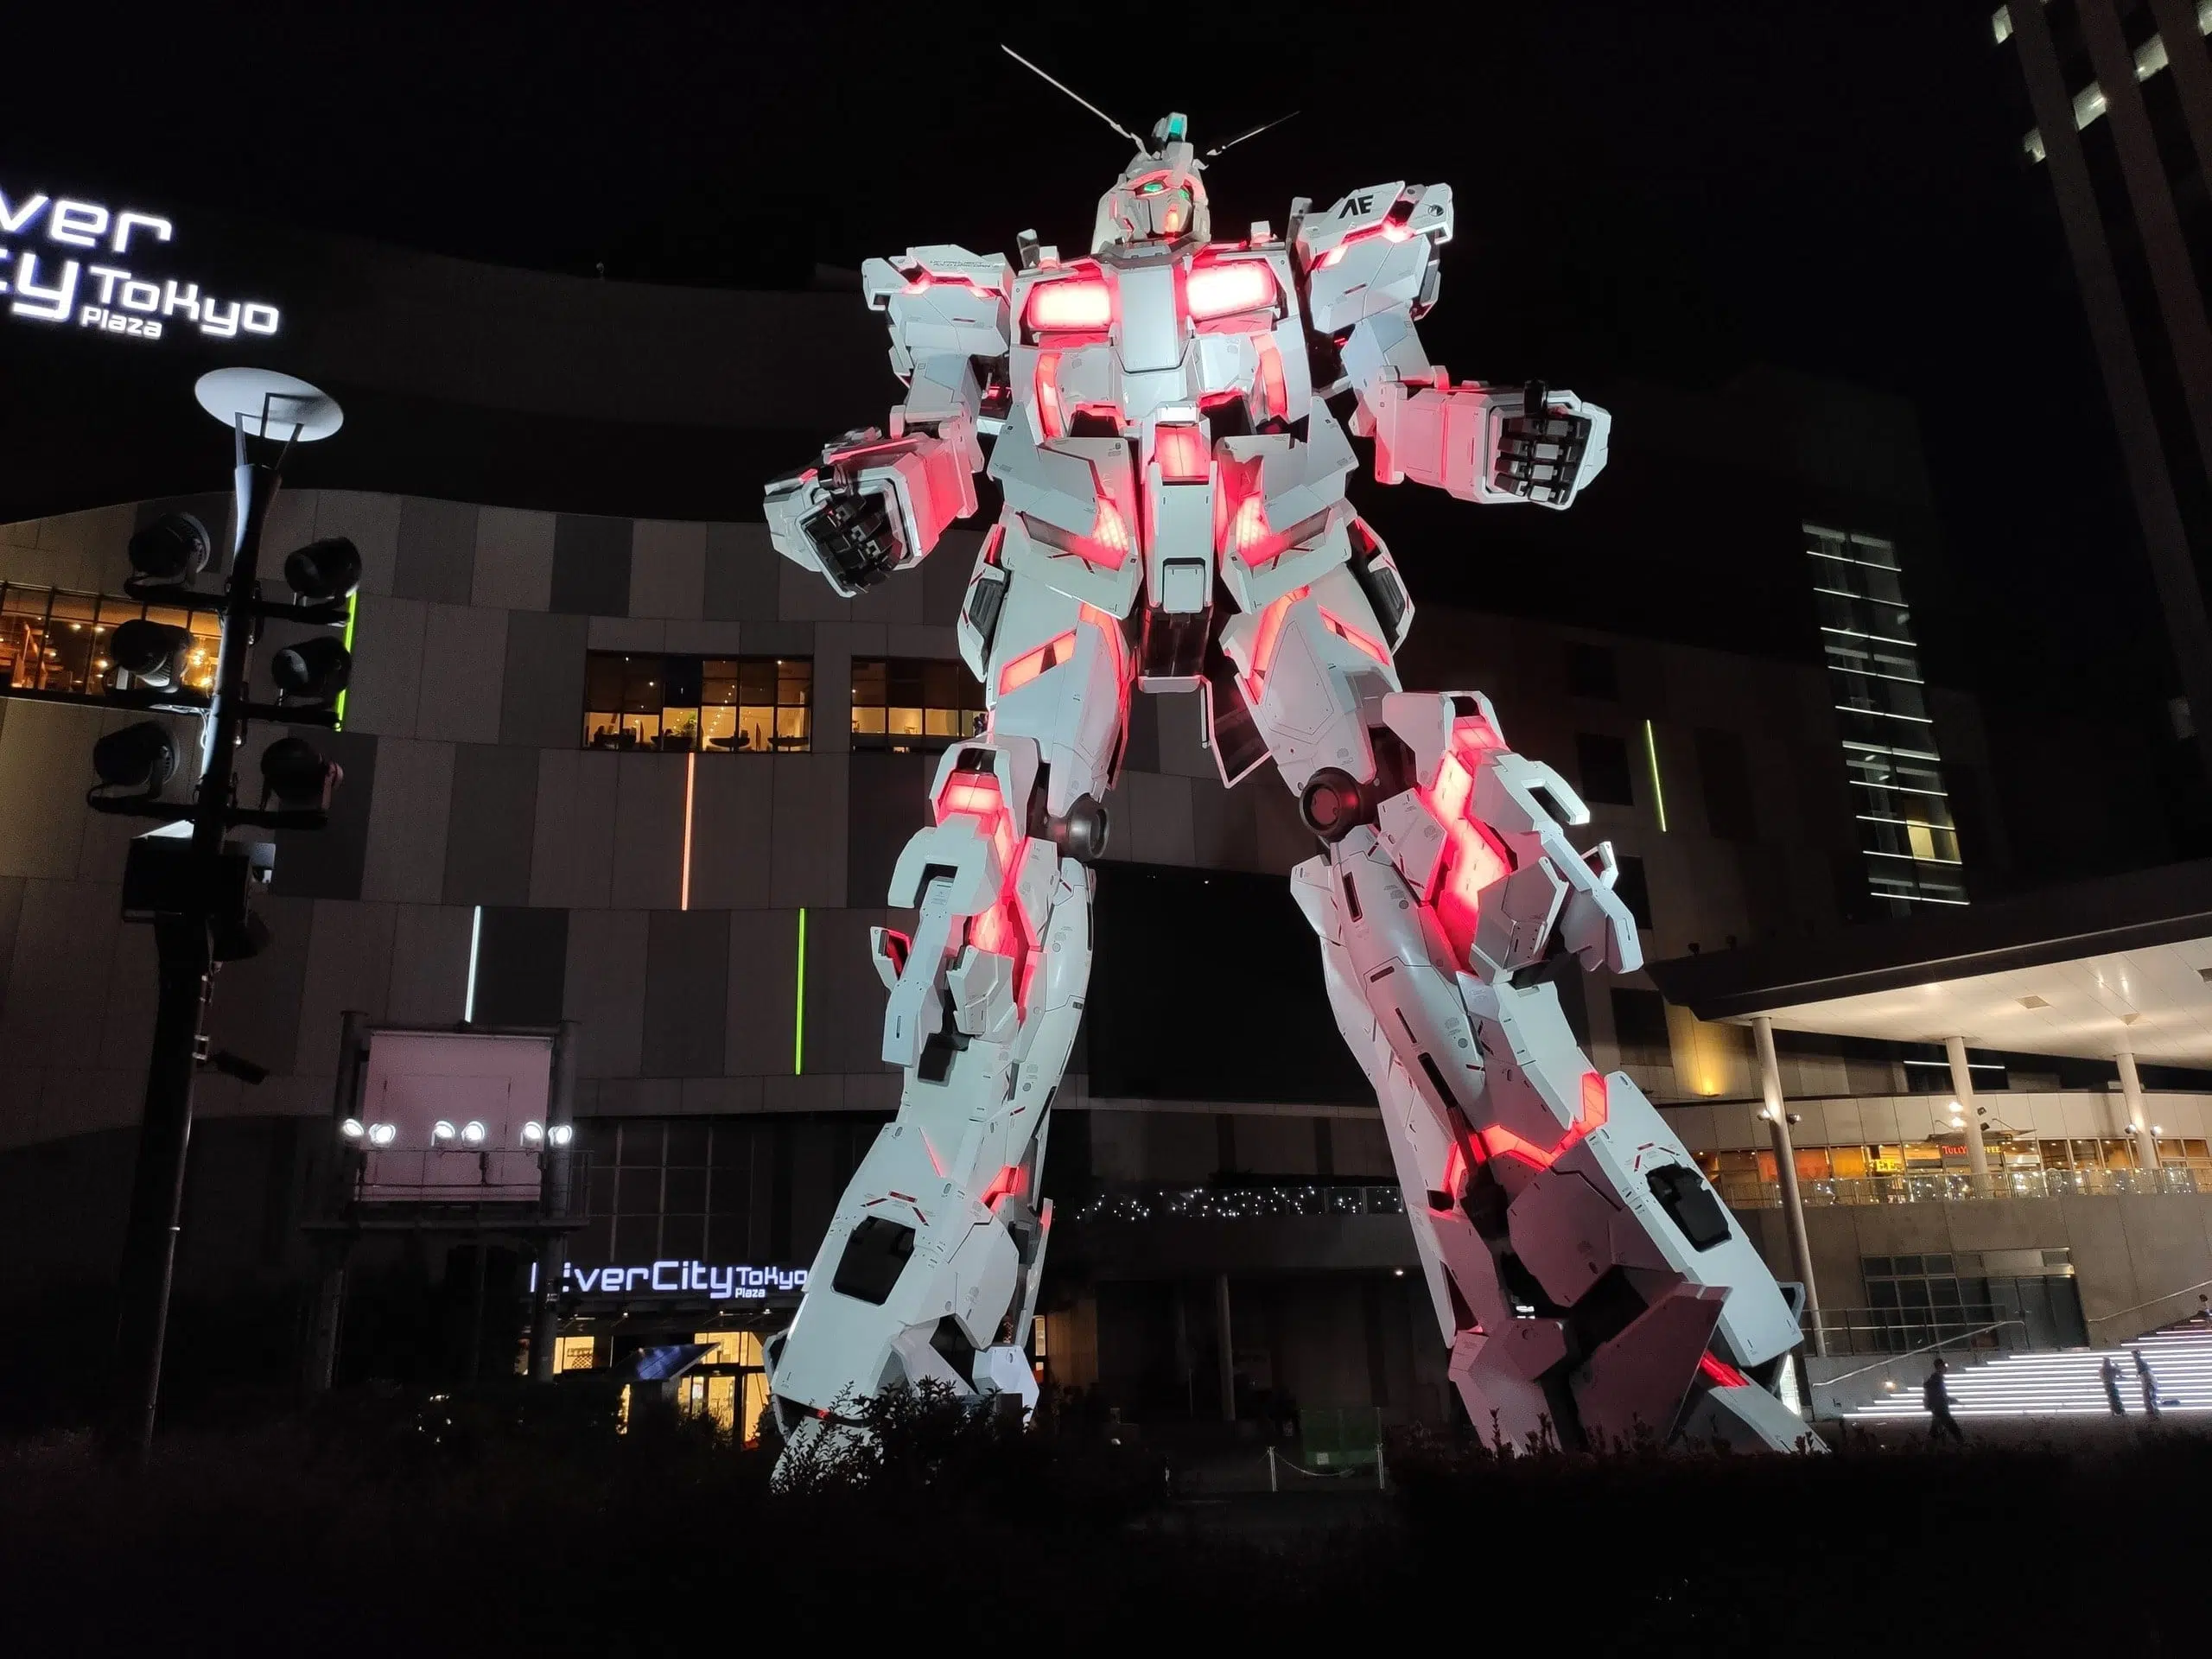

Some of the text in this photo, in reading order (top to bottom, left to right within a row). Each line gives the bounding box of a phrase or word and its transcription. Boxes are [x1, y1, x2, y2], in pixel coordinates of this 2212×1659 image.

[1338, 194, 1374, 219] AE
[80, 305, 164, 340] Plaza
[530, 1260, 734, 1300] iverCity
[734, 1287, 766, 1299] Plaza
